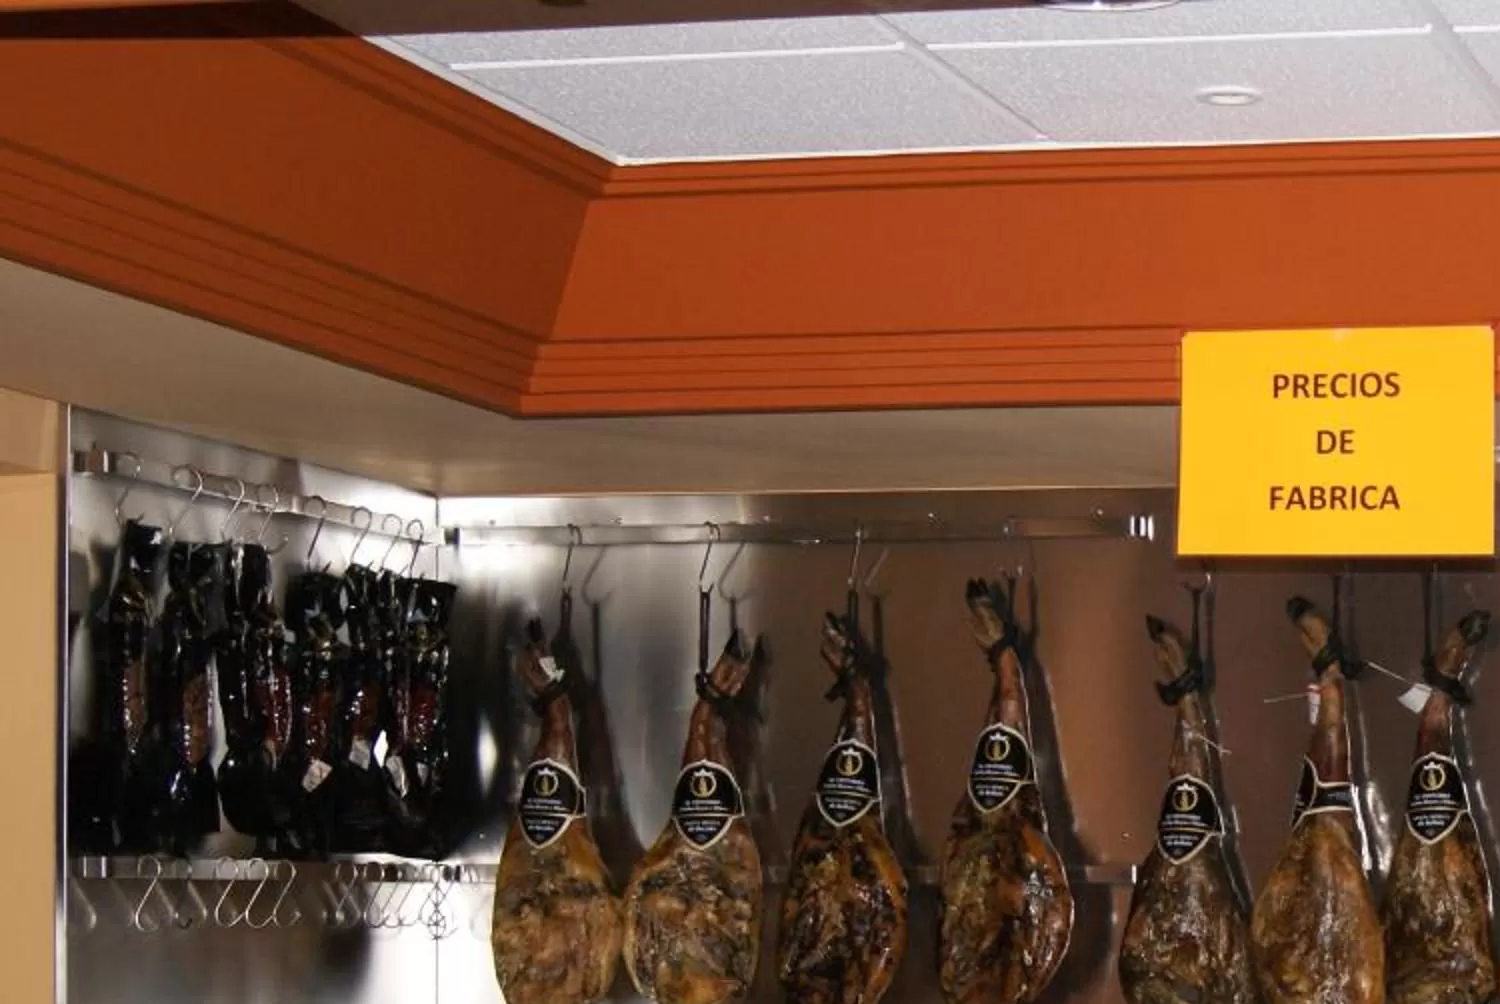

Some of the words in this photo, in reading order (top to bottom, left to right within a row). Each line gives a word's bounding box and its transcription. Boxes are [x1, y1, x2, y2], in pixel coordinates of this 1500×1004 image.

[1273, 372, 1401, 398] PRECIOS
[1316, 430, 1355, 455] DE
[1269, 485, 1401, 510] FABRICA
